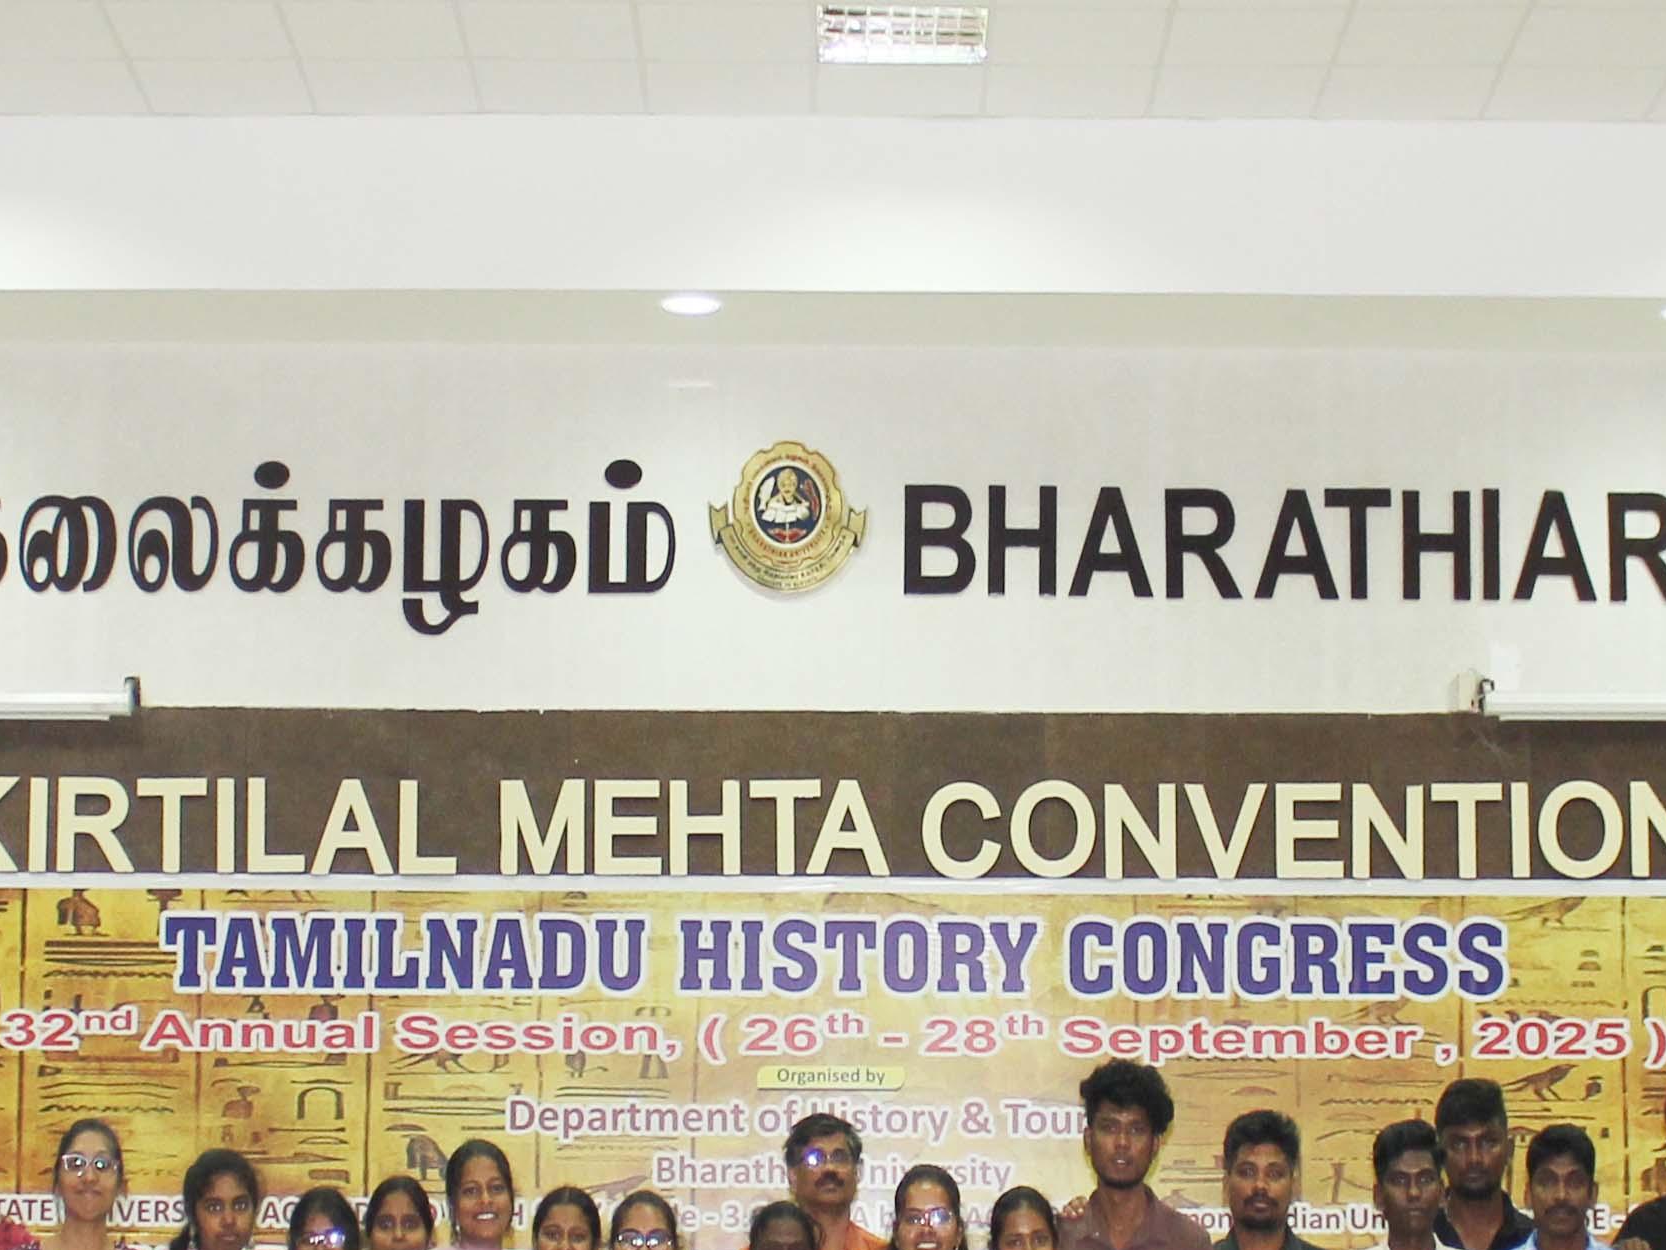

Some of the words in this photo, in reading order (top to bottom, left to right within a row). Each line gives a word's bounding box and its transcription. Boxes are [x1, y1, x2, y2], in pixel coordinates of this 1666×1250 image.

[500, 778, 890, 875] MEHTA
[164, 916, 646, 992] TAMILNADU
[679, 918, 1037, 993] HISTORY
[1068, 920, 1504, 996] CONGRESS
[3, 1009, 133, 1047] 32nd
[145, 1013, 374, 1049] Annual
[399, 1014, 677, 1058] Session,
[744, 1013, 865, 1052] 26th
[923, 1014, 1045, 1054] 28th
[1062, 1018, 1419, 1061] September
[1478, 1020, 1629, 1056] 2025
[776, 1067, 861, 1086] Organised
[865, 1067, 886, 1086] by
[509, 1099, 746, 1139] Department
[758, 1099, 799, 1133] of
[961, 1102, 992, 1135] &
[655, 1155, 786, 1185] Bharath
